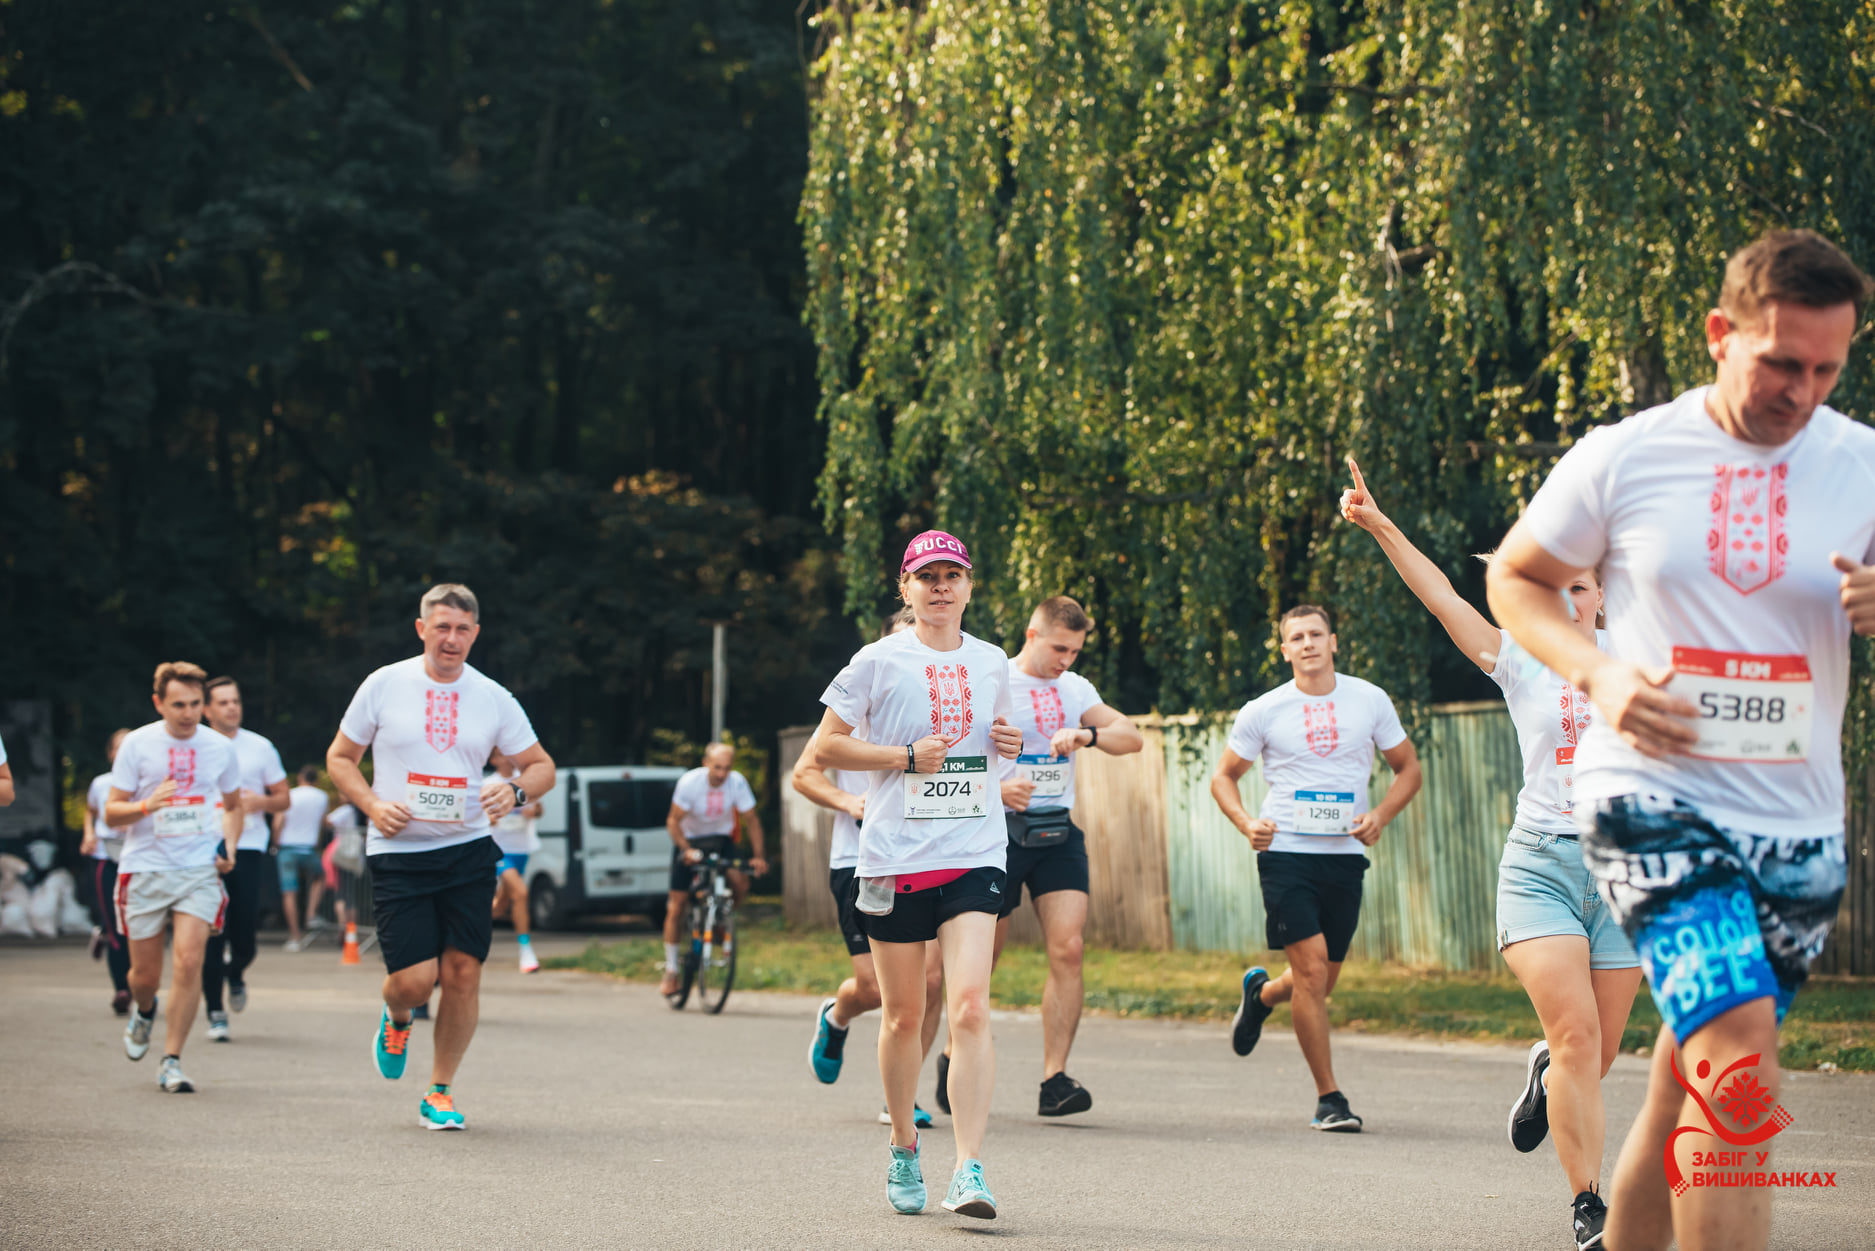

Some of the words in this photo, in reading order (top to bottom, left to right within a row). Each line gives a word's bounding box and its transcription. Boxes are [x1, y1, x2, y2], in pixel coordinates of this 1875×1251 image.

[1700, 692, 1785, 723] 5388
[950, 762, 965, 772] KM
[1031, 769, 1061, 782] 1296
[923, 781, 971, 797] 2074
[418, 792, 454, 806] 5078
[1310, 807, 1340, 820] 1298
